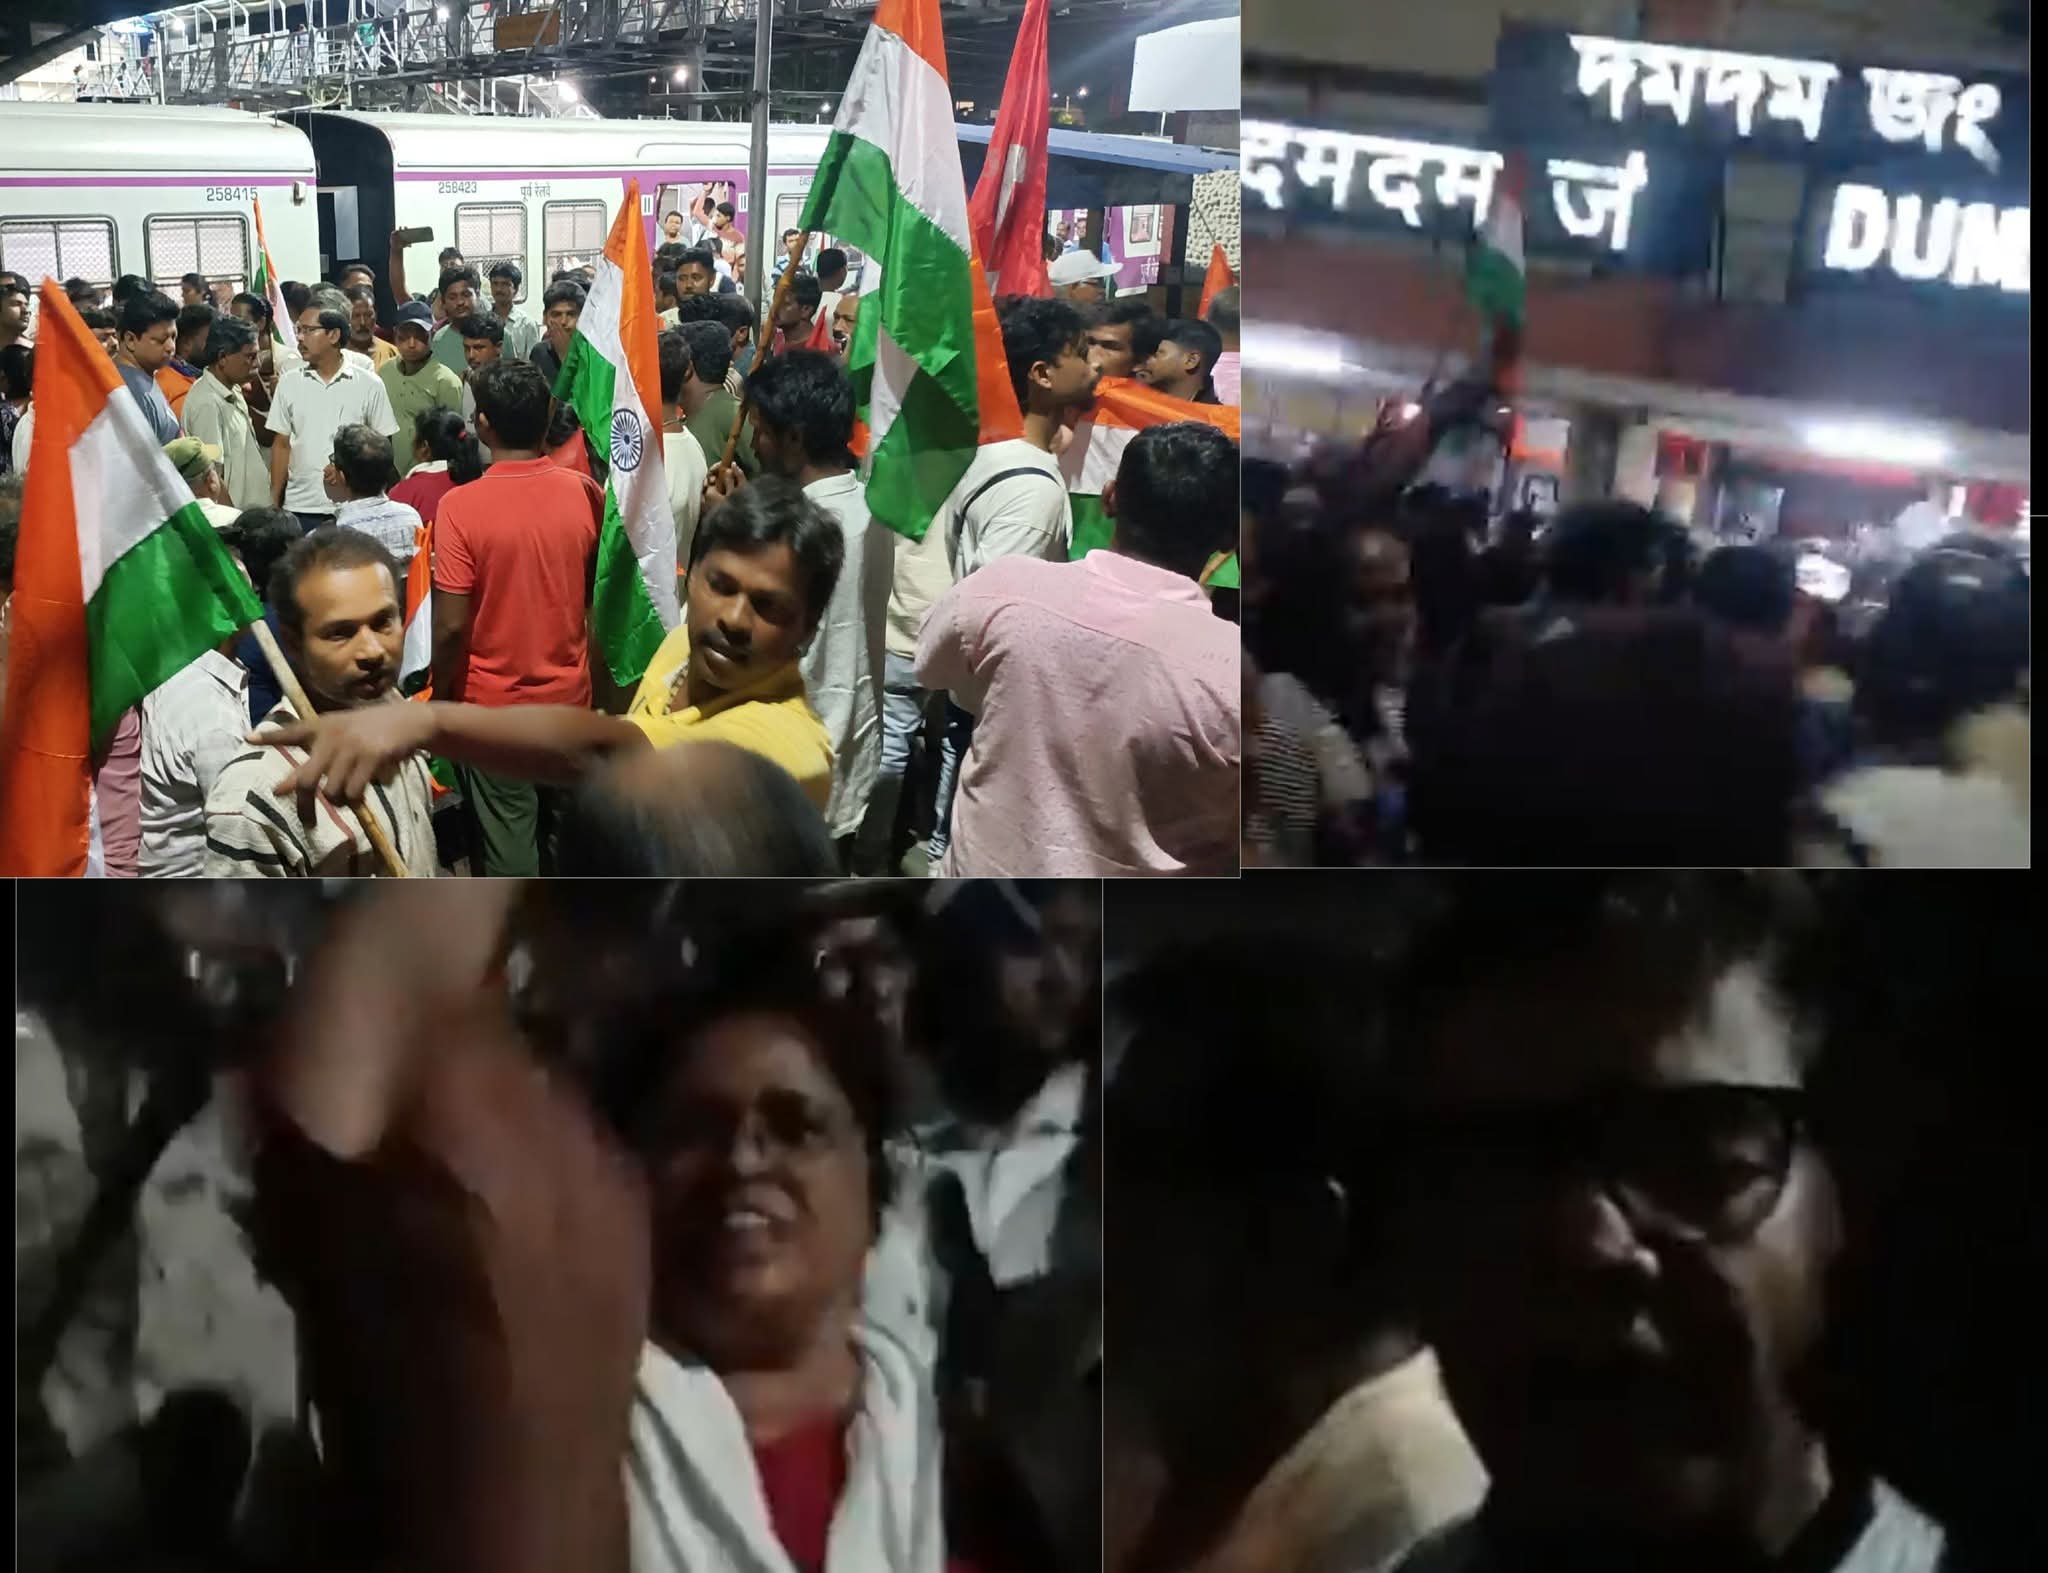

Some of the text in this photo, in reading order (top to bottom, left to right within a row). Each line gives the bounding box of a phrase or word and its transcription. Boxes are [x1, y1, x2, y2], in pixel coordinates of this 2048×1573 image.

[1567, 34, 2001, 175] দমদম জং
[206, 187, 258, 201] 258415
[438, 181, 477, 194] 258423
[1240, 119, 1648, 250] दमदम जं
[1824, 183, 2031, 292] DUM
